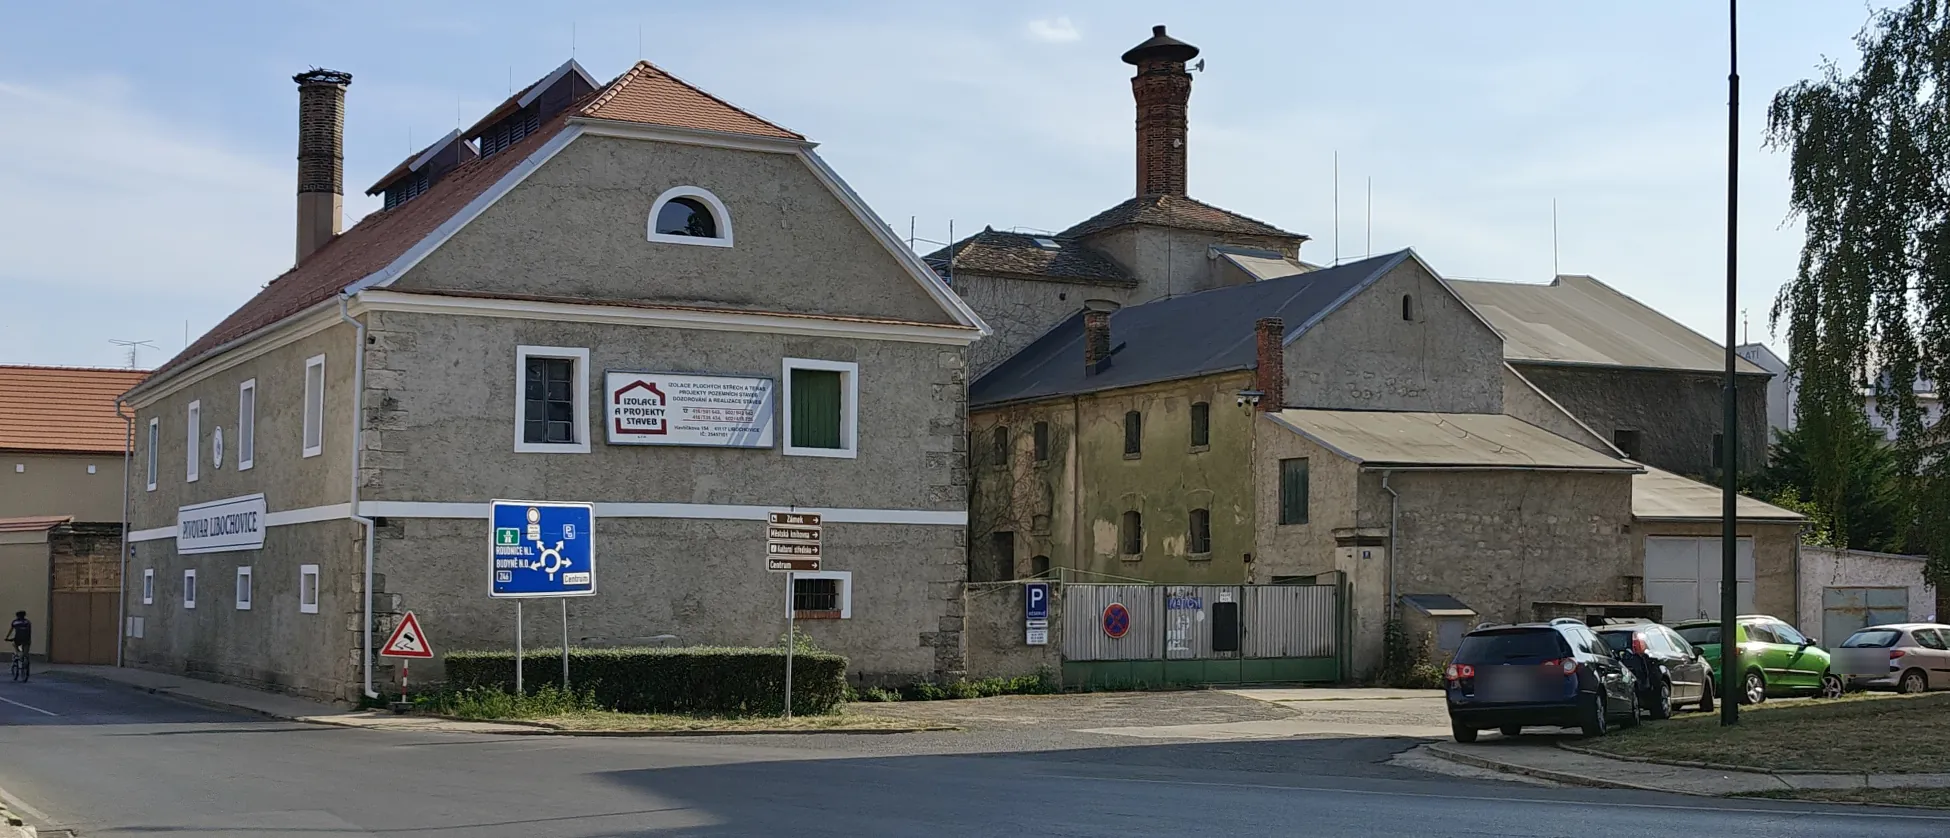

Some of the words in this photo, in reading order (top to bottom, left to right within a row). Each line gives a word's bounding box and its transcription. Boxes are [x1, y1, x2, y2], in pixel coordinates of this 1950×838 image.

[623, 397, 657, 406] IZOLACE
[615, 407, 621, 416] A
[623, 407, 665, 417] PROJEKTY
[626, 417, 658, 425] STAVEB
[787, 515, 803, 523] Zámek
[183, 519, 208, 539] PIVOVAR
[210, 511, 257, 536] LIBOCHOVICE
[771, 529, 789, 538] Městská
[790, 530, 810, 538] knihovna
[496, 546, 523, 556] ROUDNICE
[496, 557, 518, 568] BUDYNĚ
[770, 560, 791, 569] Centrum
[565, 575, 588, 583] Centrum
[1031, 588, 1043, 608] P
